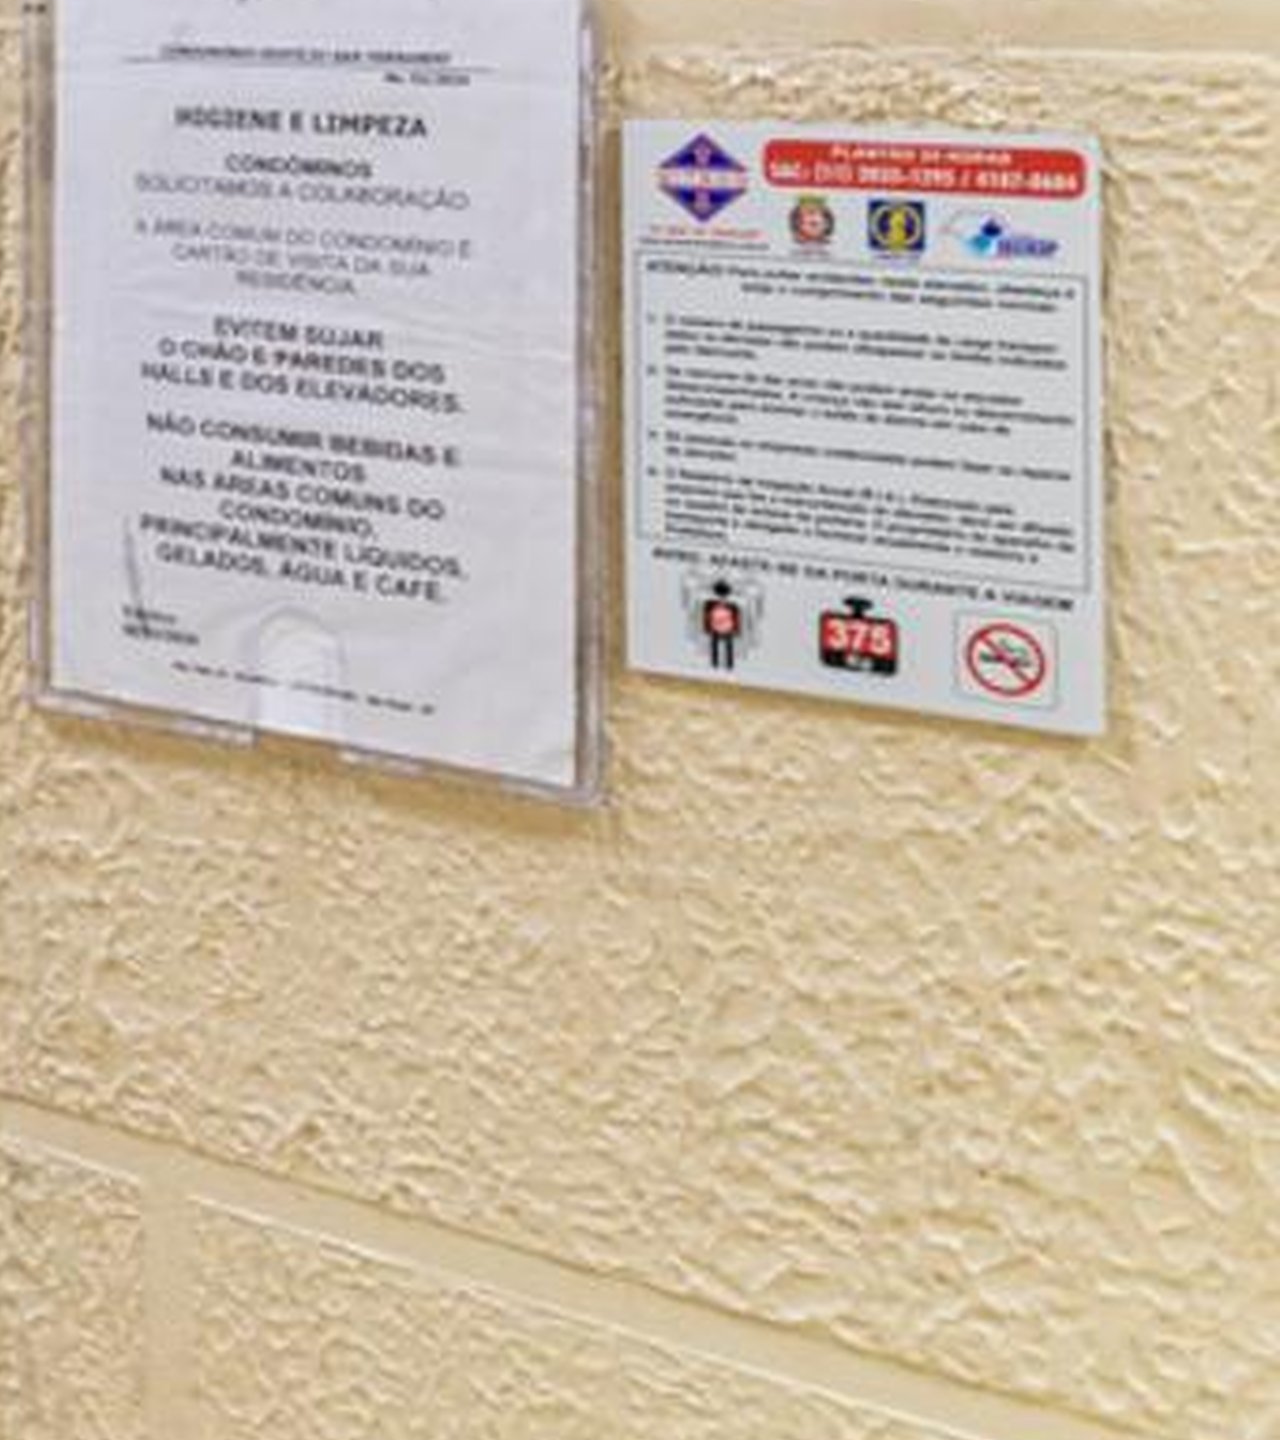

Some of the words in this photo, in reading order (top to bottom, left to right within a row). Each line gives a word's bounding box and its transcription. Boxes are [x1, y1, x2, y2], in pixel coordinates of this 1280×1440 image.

[175, 107, 281, 133] HIGIENE
[289, 110, 303, 132] E
[313, 112, 428, 138] LIMPEZA
[137, 172, 273, 198] SOLICITAMOS
[279, 181, 291, 198] A
[298, 181, 471, 212] COLABORAÇÃO
[136, 220, 148, 234] A
[206, 221, 282, 243] COMUM
[288, 228, 316, 246] DO
[255, 248, 278, 267] DE
[353, 255, 382, 274] DA
[389, 258, 431, 277] SUA
[213, 316, 298, 343] EVITEM
[304, 325, 385, 350] SUJAR
[141, 361, 213, 388] HALLS
[219, 369, 236, 391] E
[241, 372, 290, 396] DOS
[158, 337, 177, 358] O
[180, 339, 248, 365] CHÃO
[252, 346, 268, 366] E
[272, 349, 387, 379] PAREDES
[391, 358, 446, 386] DOS
[146, 410, 197, 436] NÃO
[199, 419, 323, 450] CONSUMIR
[328, 433, 437, 465] BEBIDAS
[442, 446, 459, 469] E
[230, 448, 367, 483] ALIMENTOS
[159, 466, 207, 491] NAS
[295, 482, 401, 516] COMUNS
[405, 498, 445, 520] DO
[140, 511, 336, 560] PRINCIPALMENTE
[352, 571, 368, 592] E
[825, 619, 893, 656] 375
